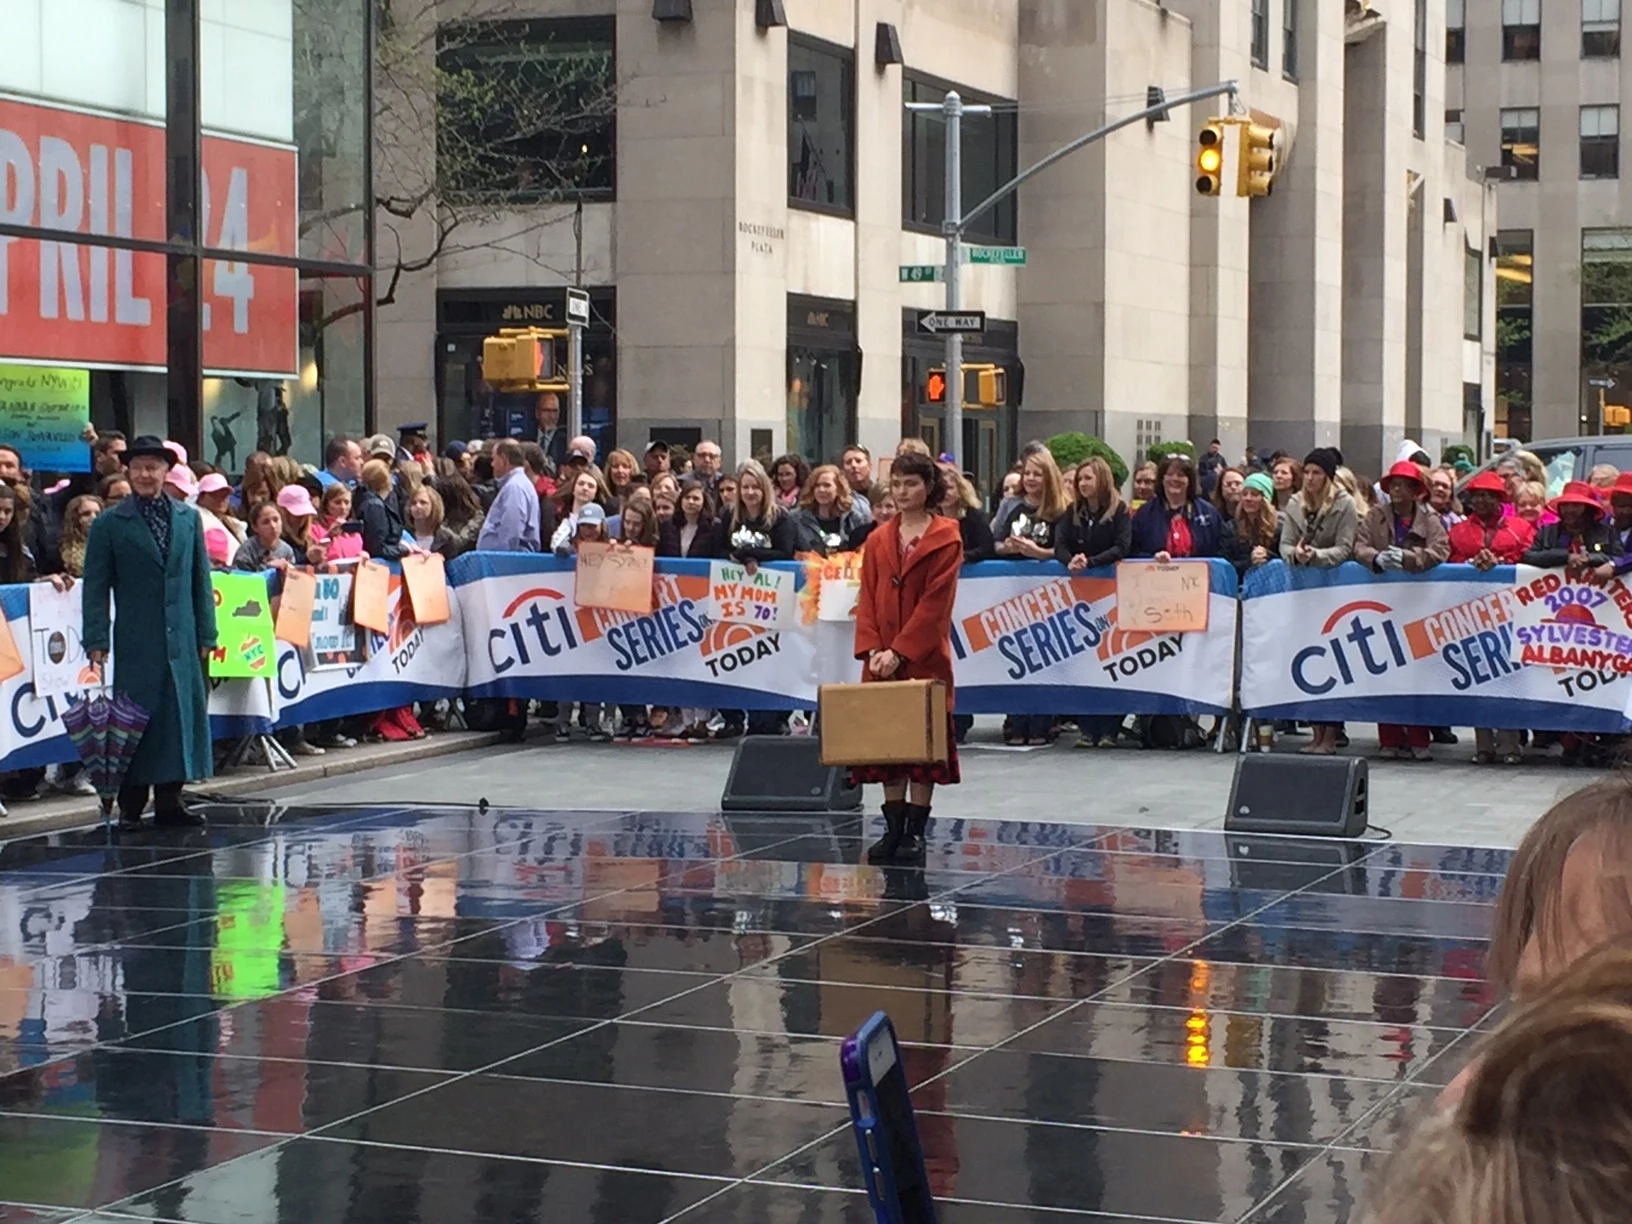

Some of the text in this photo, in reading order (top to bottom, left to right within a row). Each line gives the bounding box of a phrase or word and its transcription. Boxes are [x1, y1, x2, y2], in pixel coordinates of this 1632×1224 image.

[201, 166, 254, 334] 4
[910, 267, 923, 280] 49
[523, 304, 553, 320] NBC
[928, 316, 976, 330] ONE WAY
[721, 567, 745, 581] HEY
[1516, 573, 1561, 606] RED
[714, 584, 777, 604] MY MOM
[721, 602, 745, 618] IS
[979, 579, 1078, 643] CONCERT
[1544, 586, 1608, 613] 2007
[488, 602, 578, 674] citi
[606, 600, 705, 672] SERIES
[1424, 588, 1514, 650] CONCER
[244, 644, 265, 662] NYC
[705, 632, 781, 677] TODAY
[998, 602, 1102, 681] SERIES
[1103, 632, 1184, 683] TODAY
[1291, 615, 1408, 695] citi
